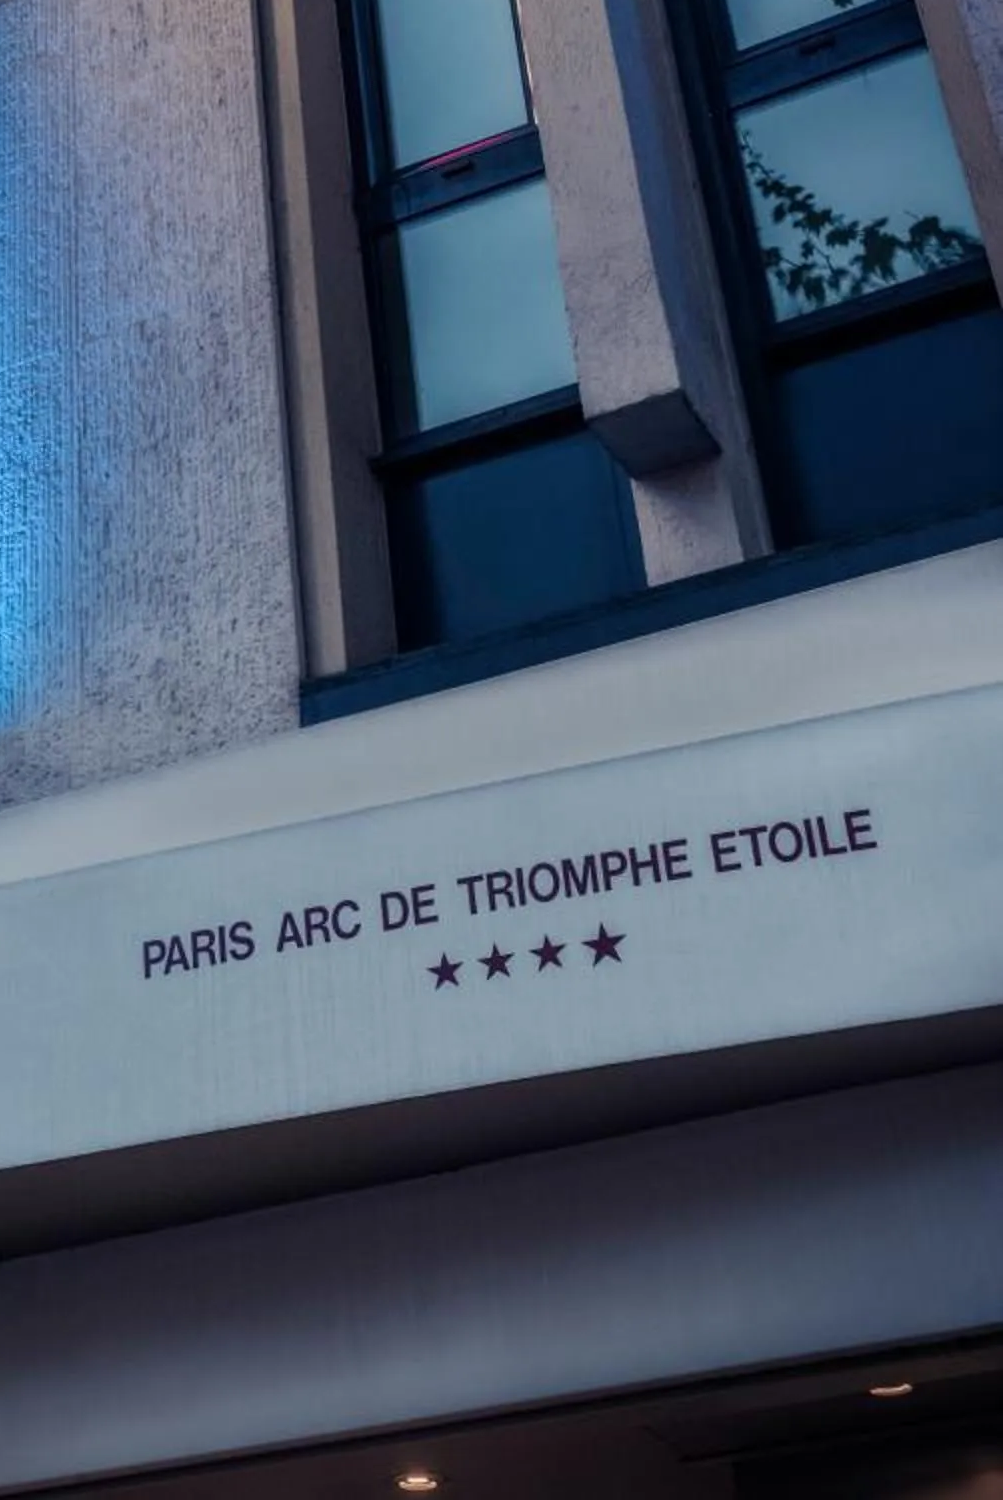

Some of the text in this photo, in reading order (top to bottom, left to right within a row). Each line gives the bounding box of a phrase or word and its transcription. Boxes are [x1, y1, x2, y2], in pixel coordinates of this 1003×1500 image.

[141, 807, 879, 981] PARIS ARC DE TRIOMPHE ETOILE
